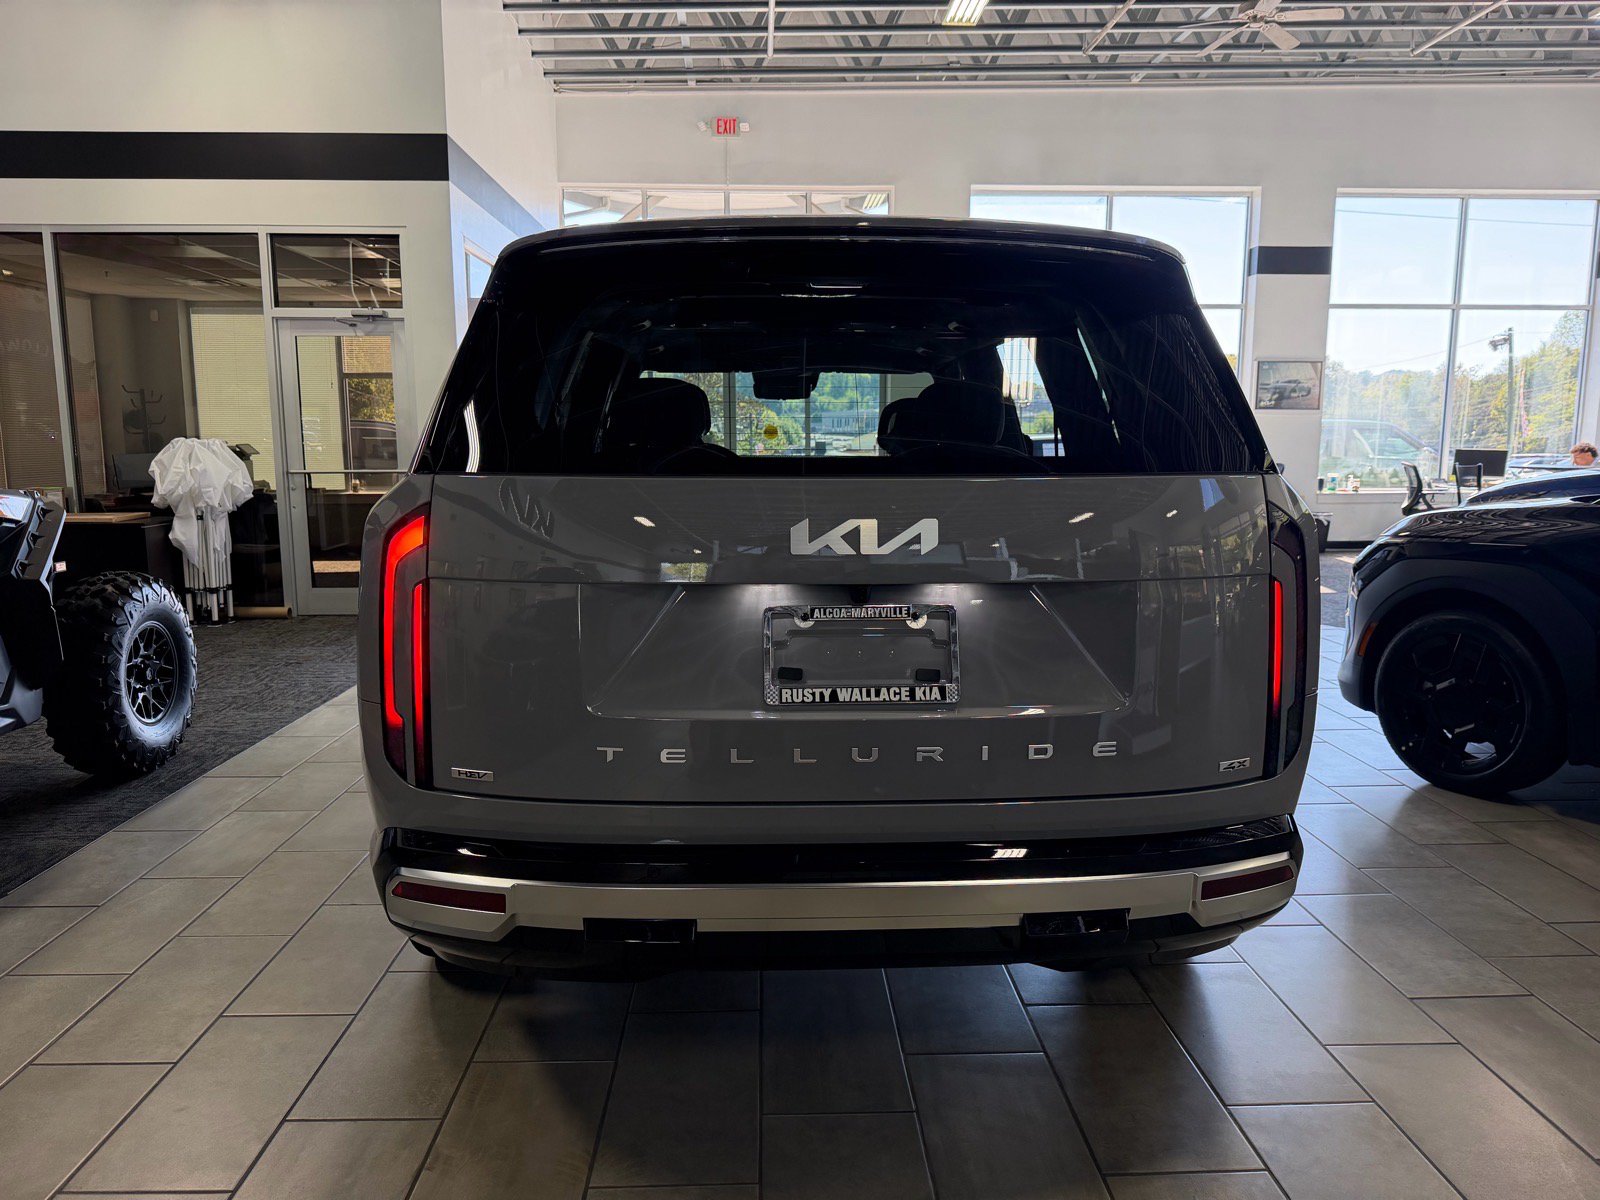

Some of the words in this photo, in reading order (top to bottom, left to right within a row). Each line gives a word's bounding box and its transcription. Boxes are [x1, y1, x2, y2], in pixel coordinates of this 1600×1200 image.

[716, 118, 737, 135] EXIT
[790, 518, 939, 555] KIA
[813, 606, 908, 619] ALCOA-MARYVILLE
[781, 687, 832, 703] RUSTY
[836, 686, 910, 703] WALLACE
[915, 686, 942, 701] KIA
[596, 741, 1118, 764] TELLURIDE
